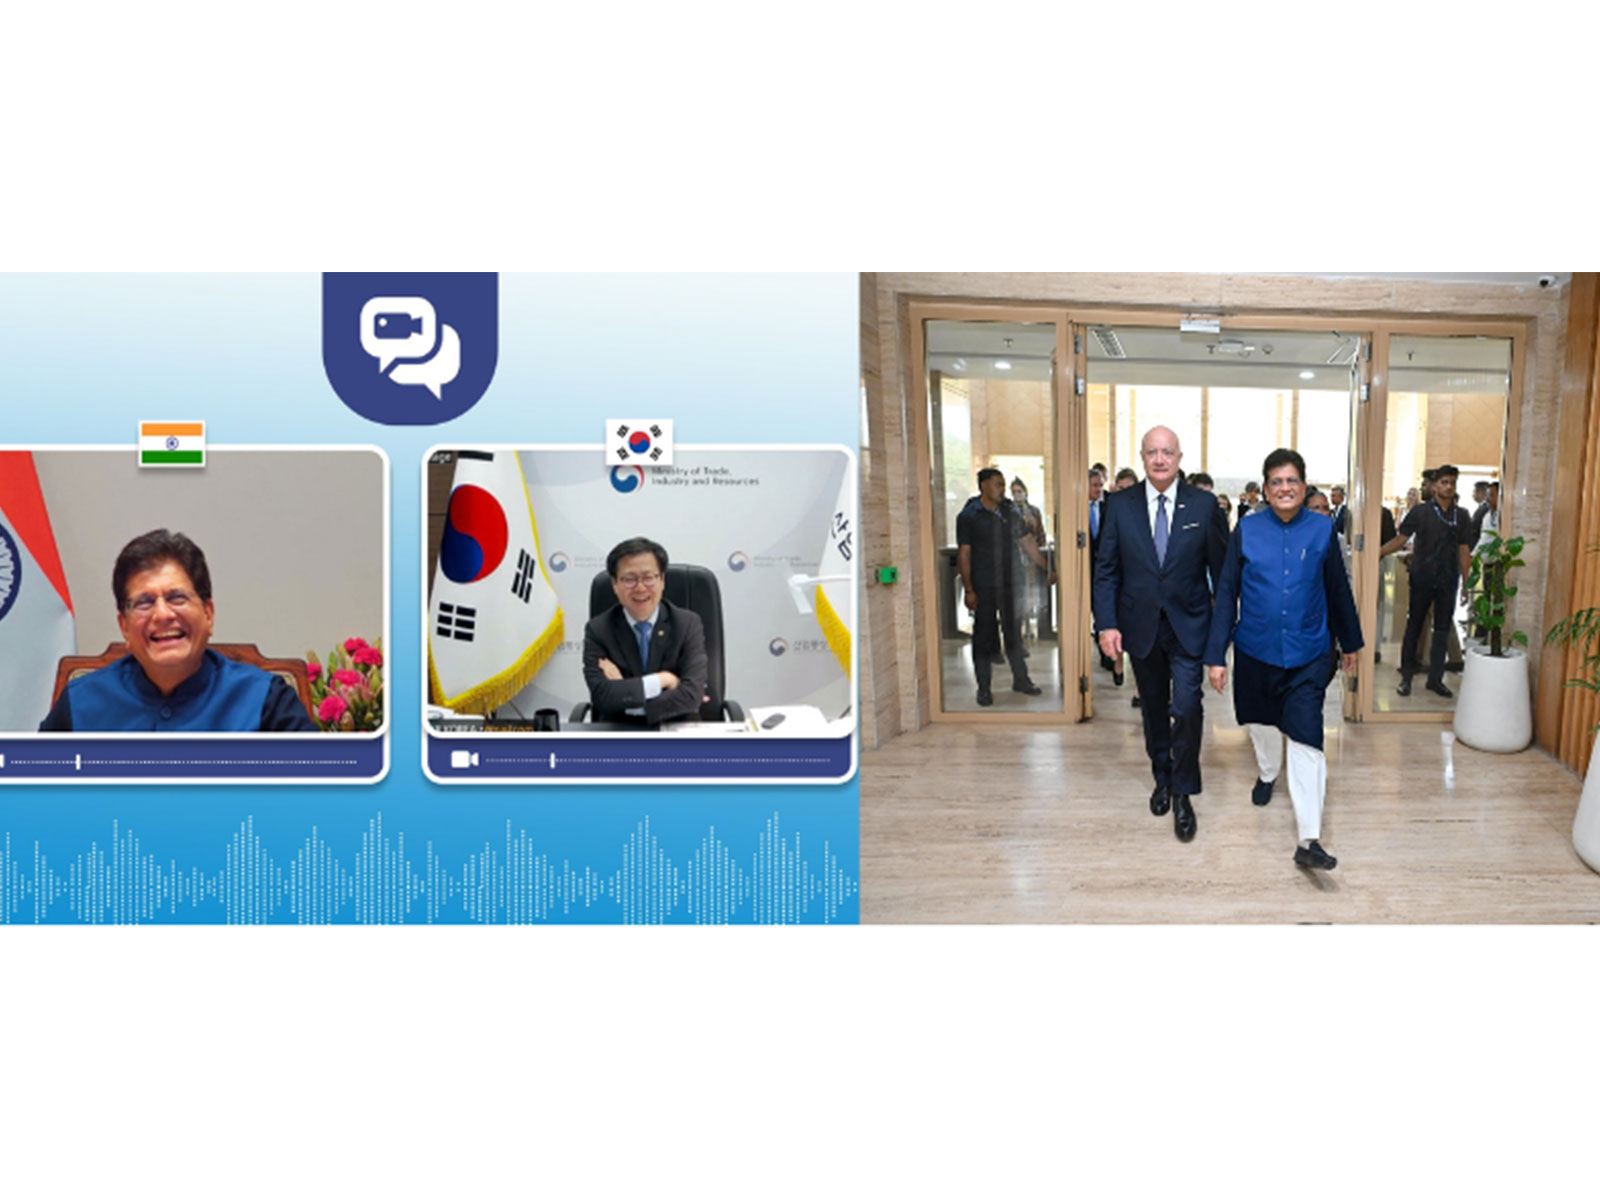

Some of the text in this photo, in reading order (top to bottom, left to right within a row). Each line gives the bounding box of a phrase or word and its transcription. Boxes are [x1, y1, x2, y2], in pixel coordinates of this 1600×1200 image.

[690, 466, 701, 475] of
[651, 477, 760, 486] Industry and Resources
